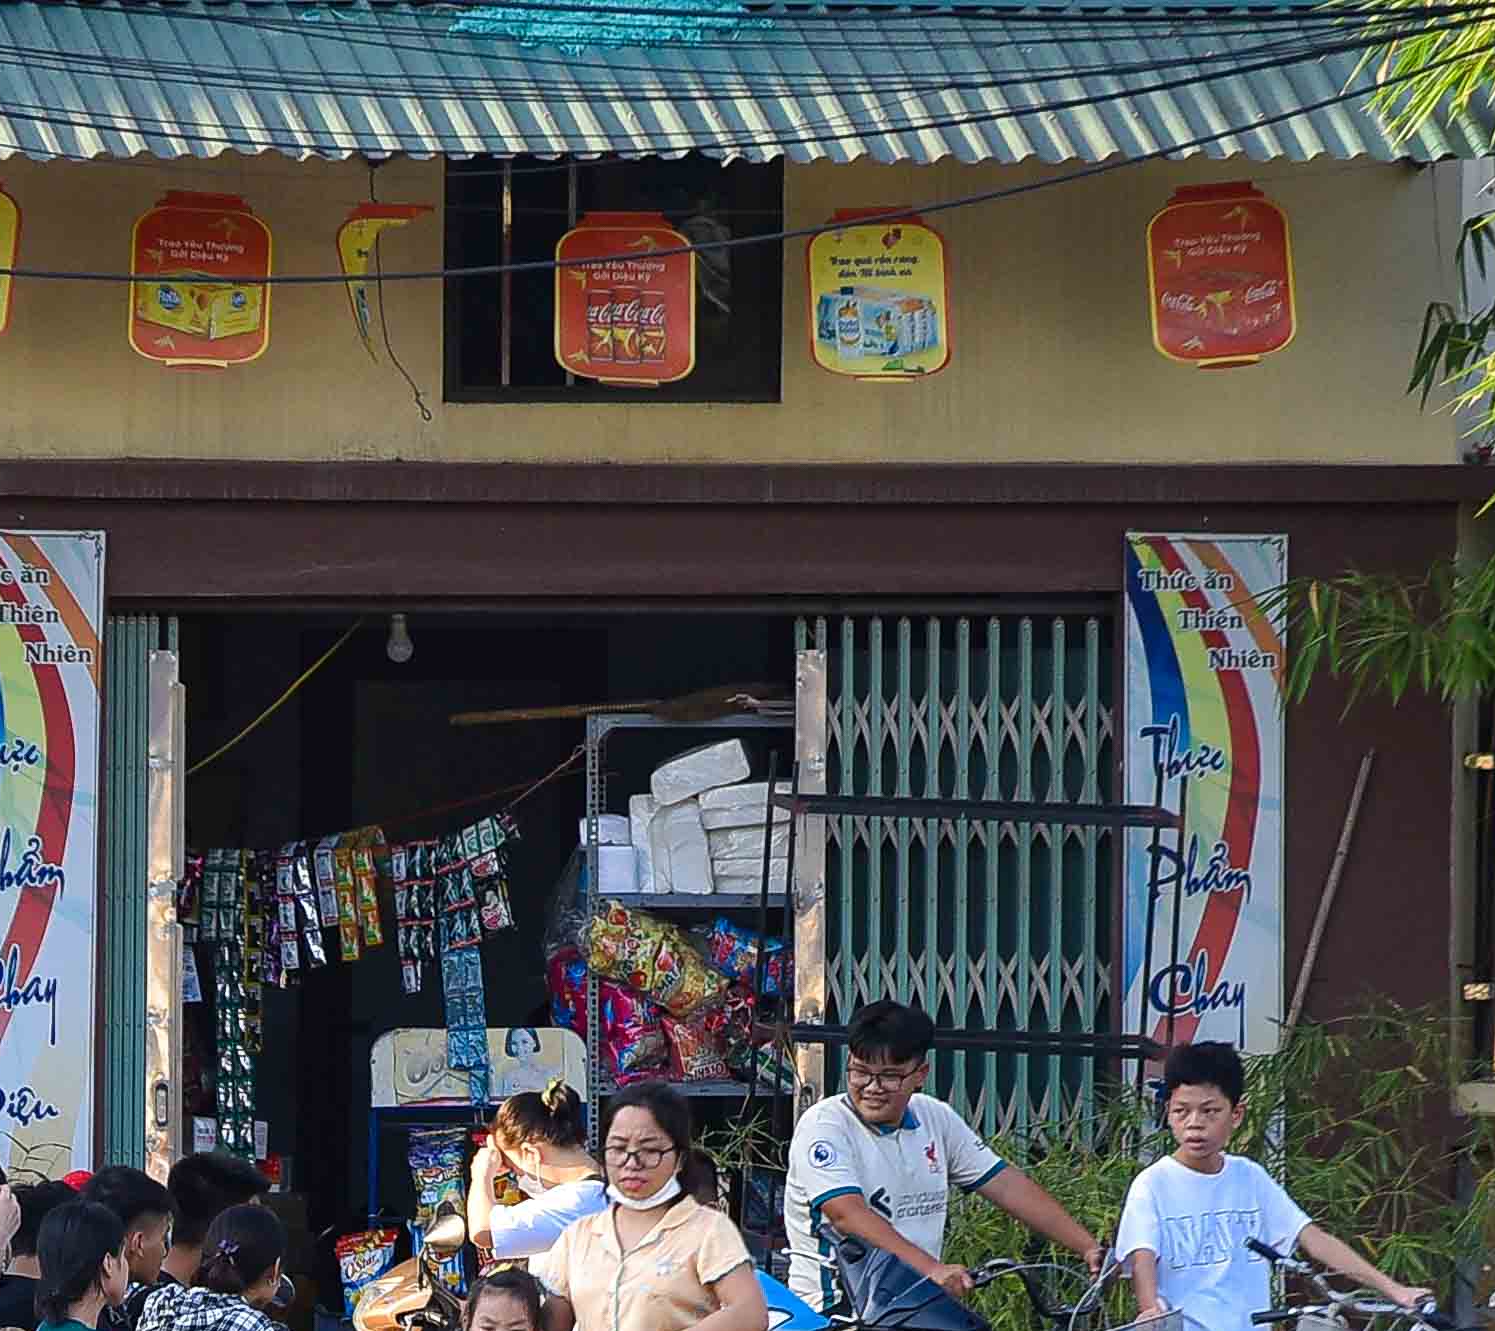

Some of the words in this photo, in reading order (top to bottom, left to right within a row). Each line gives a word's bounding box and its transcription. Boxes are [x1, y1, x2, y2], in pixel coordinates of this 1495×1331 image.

[20, 562, 49, 583] ăn
[1140, 570, 1198, 590] Thức
[1178, 608, 1243, 630] Thiên
[24, 643, 92, 664] Nhiên
[1208, 649, 1278, 669] Nhiên
[1140, 714, 1224, 778] Thực
[1146, 832, 1252, 904] Phẩm
[1149, 950, 1247, 1051] Chay
